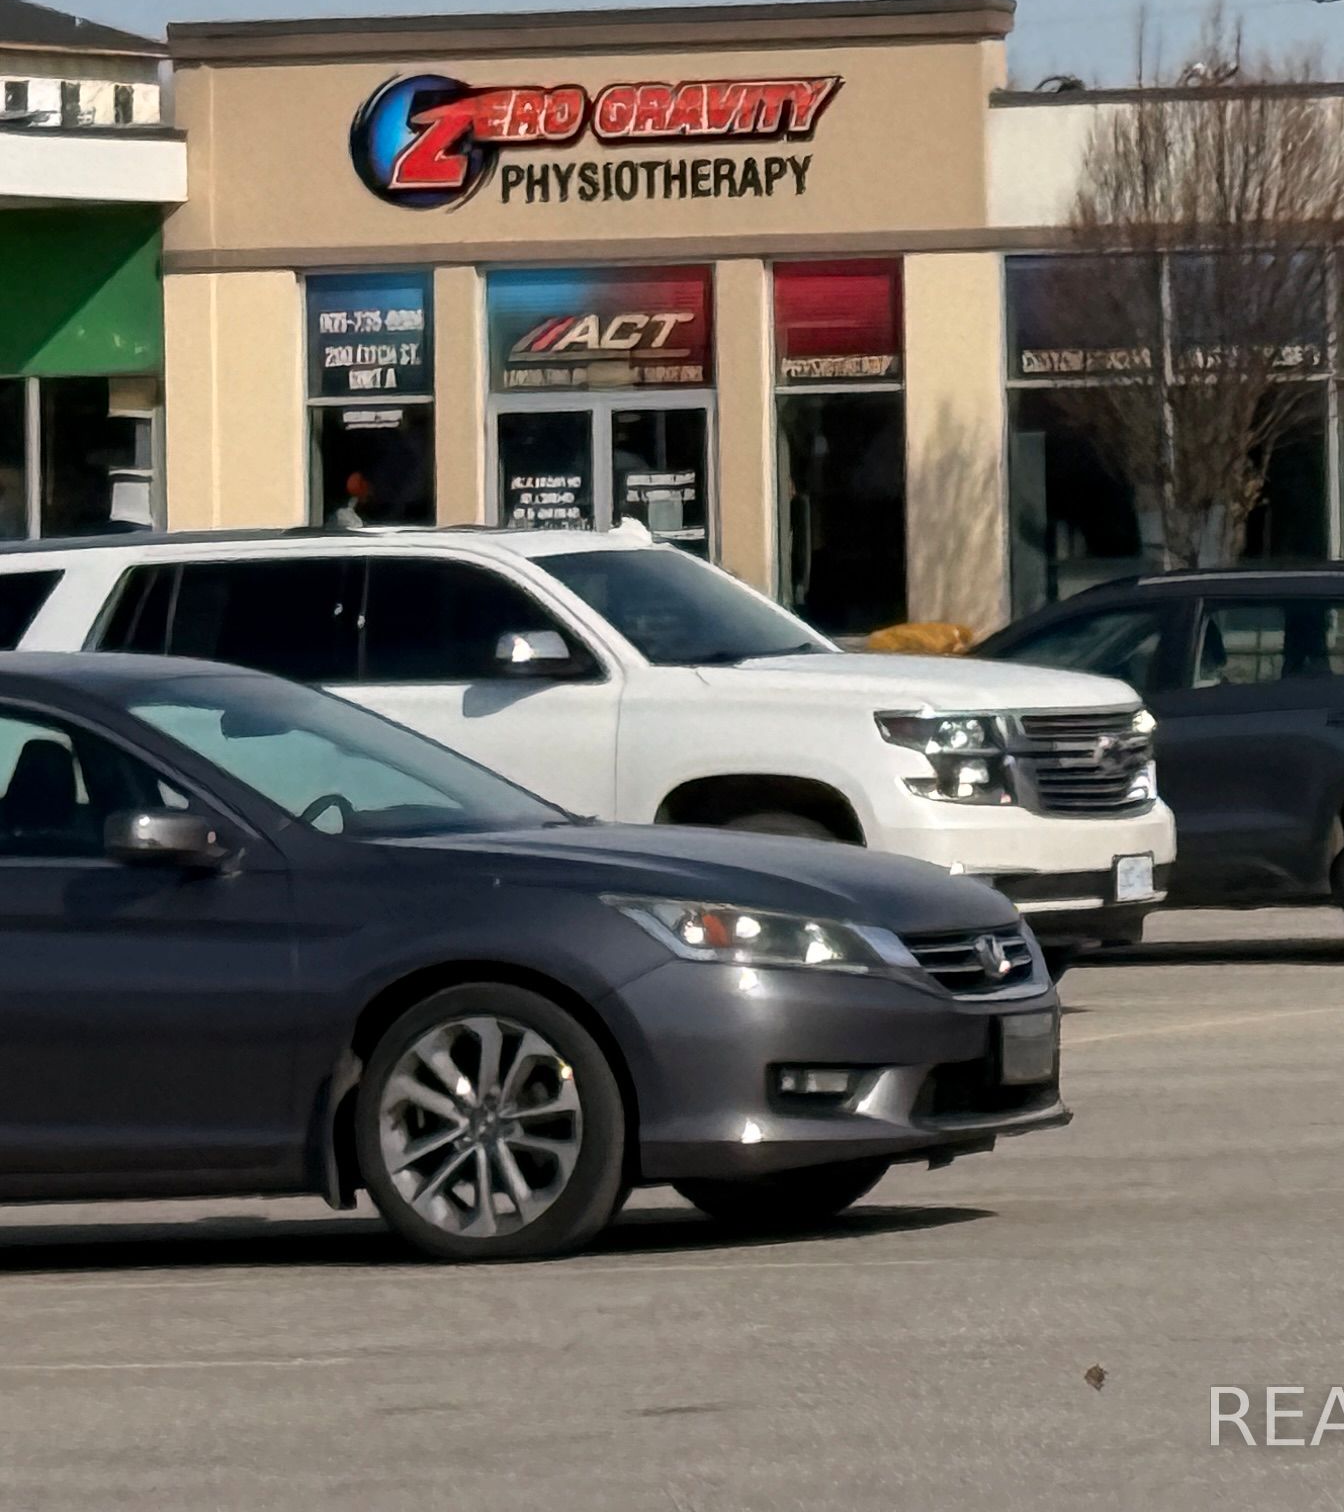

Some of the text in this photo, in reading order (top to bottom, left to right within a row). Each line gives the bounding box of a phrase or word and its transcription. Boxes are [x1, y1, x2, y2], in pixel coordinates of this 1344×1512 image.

[594, 76, 841, 138] GRAVITY
[501, 154, 812, 204] PHYSIOTHERAPY
[552, 312, 695, 351] ACT
